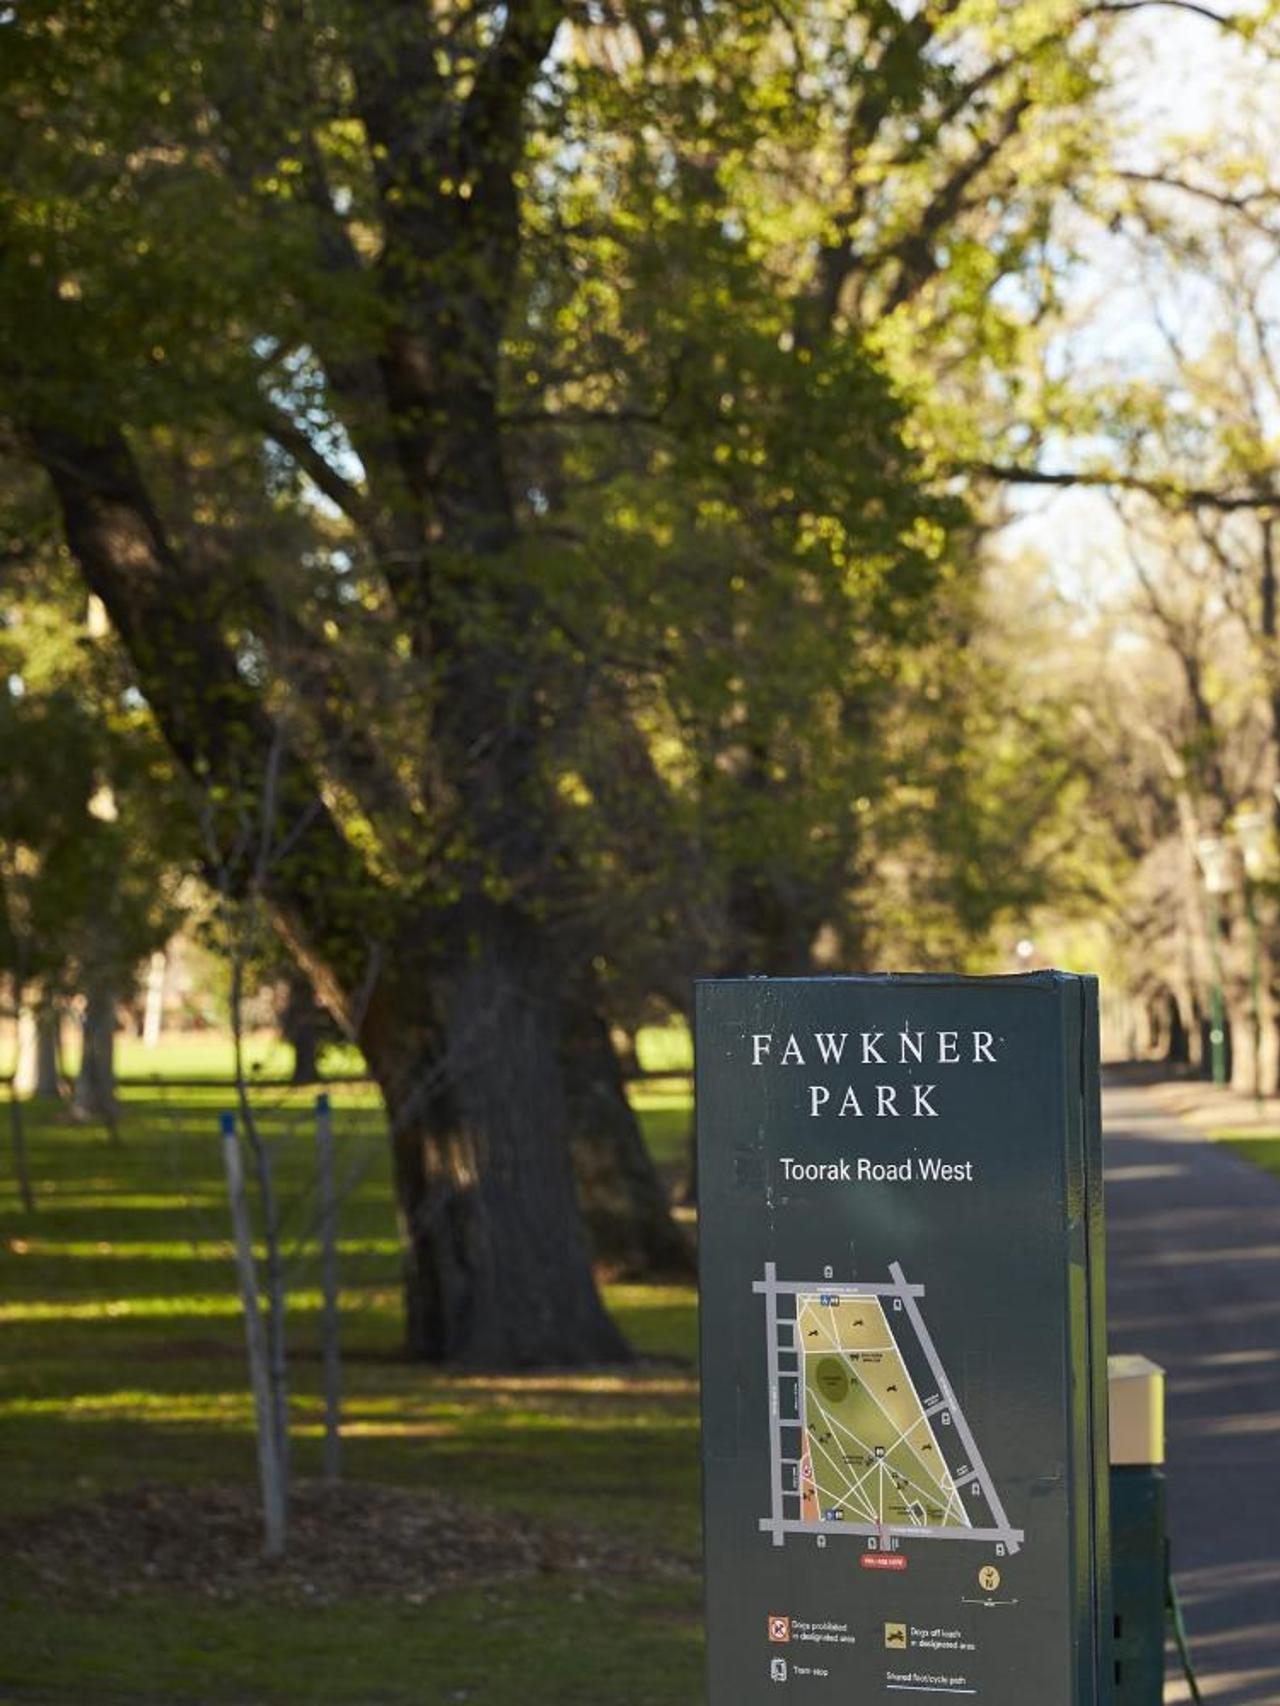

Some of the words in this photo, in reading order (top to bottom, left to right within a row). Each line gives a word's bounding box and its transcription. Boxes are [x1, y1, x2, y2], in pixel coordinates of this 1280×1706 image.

[751, 1031, 997, 1066] FAWKNER
[809, 1084, 939, 1117] PARK
[780, 1158, 851, 1181] Toorak
[857, 1158, 912, 1181] Road
[918, 1158, 973, 1181] West
[910, 1627, 928, 1638] Dogs
[886, 1671, 911, 1681] Shared
